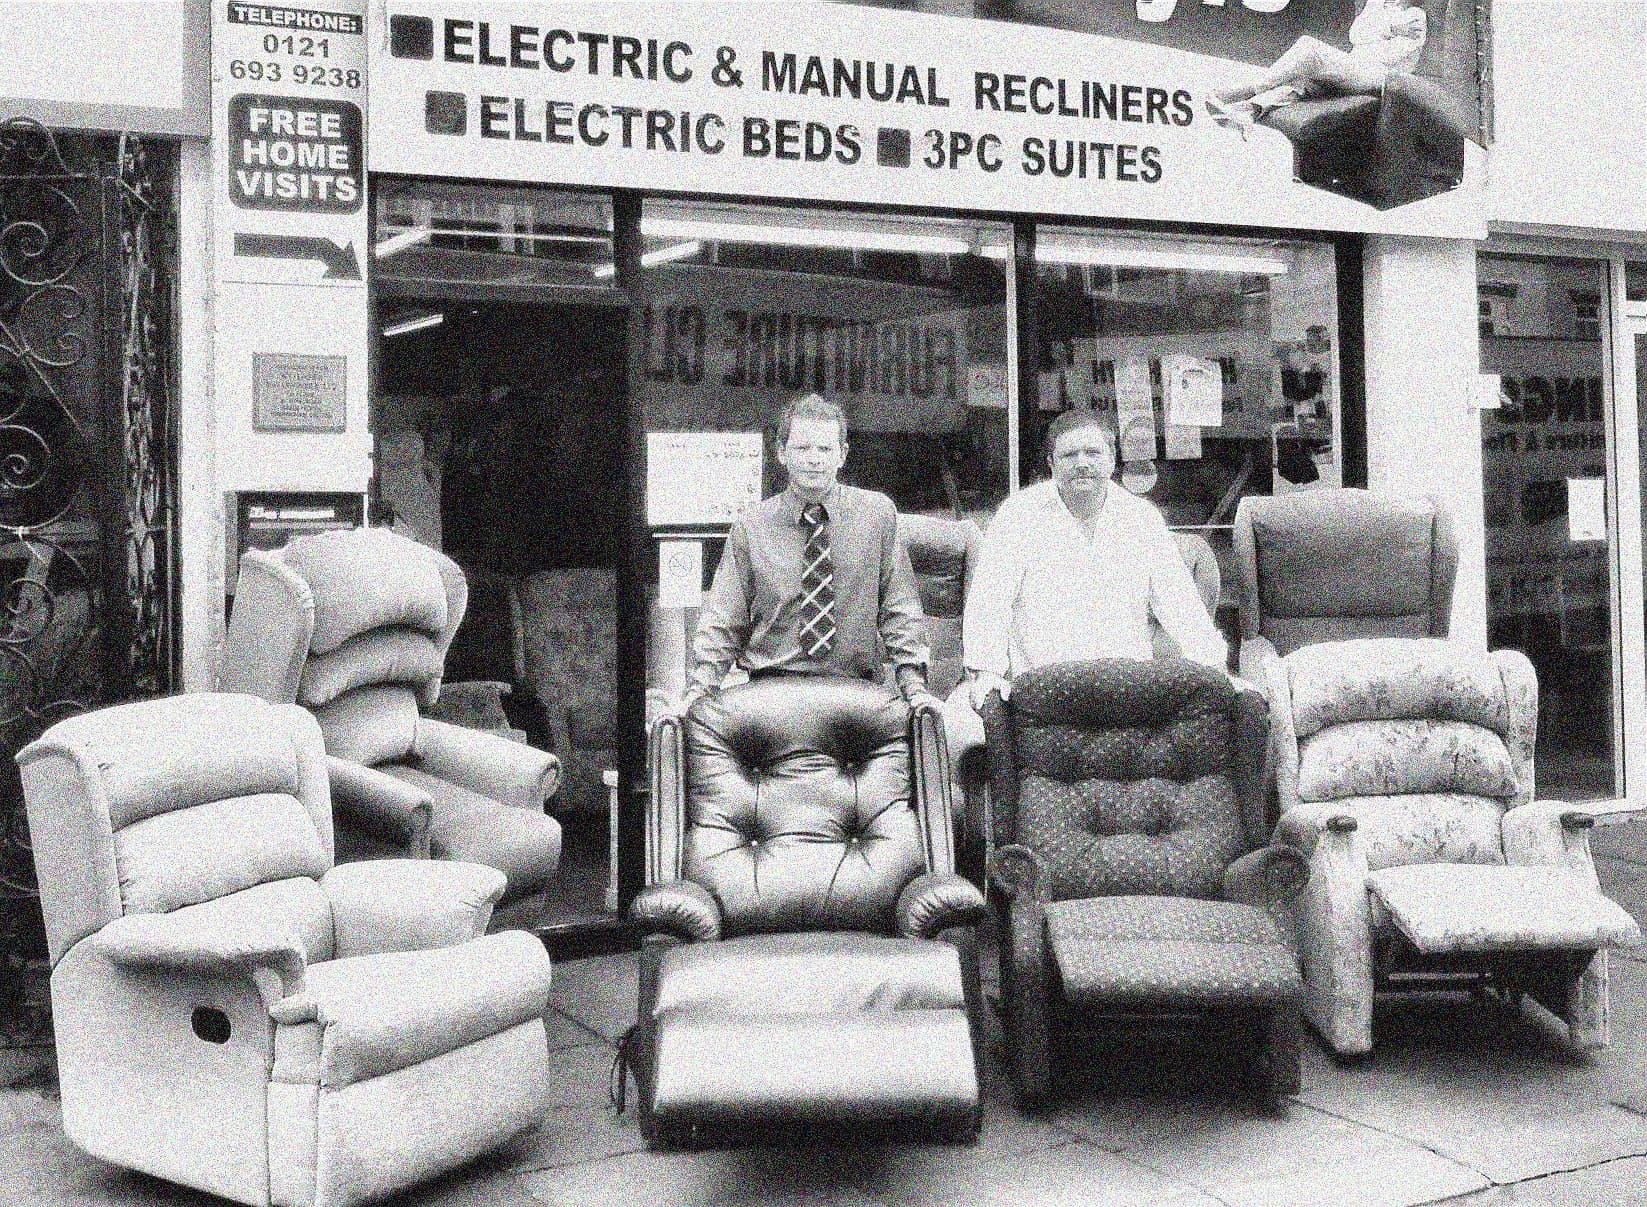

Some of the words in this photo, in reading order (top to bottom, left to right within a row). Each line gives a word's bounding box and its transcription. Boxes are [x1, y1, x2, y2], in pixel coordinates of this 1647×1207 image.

[233, 6, 357, 32] TELEPHONE:
[262, 34, 330, 58] 0121
[230, 59, 282, 83] 693
[293, 63, 361, 89] 9238
[444, 18, 694, 84] ELECTRIC
[711, 46, 743, 88] &
[762, 51, 950, 107] MANUAL
[974, 72, 1193, 126] RECLINERS
[248, 106, 342, 138] FREE
[242, 139, 350, 170] HOME
[480, 95, 725, 154] ELECTRIC
[743, 116, 862, 165] BEDS
[923, 129, 1003, 172] 3PC
[1022, 137, 1163, 184] SUITES
[236, 172, 359, 203] VISITS
